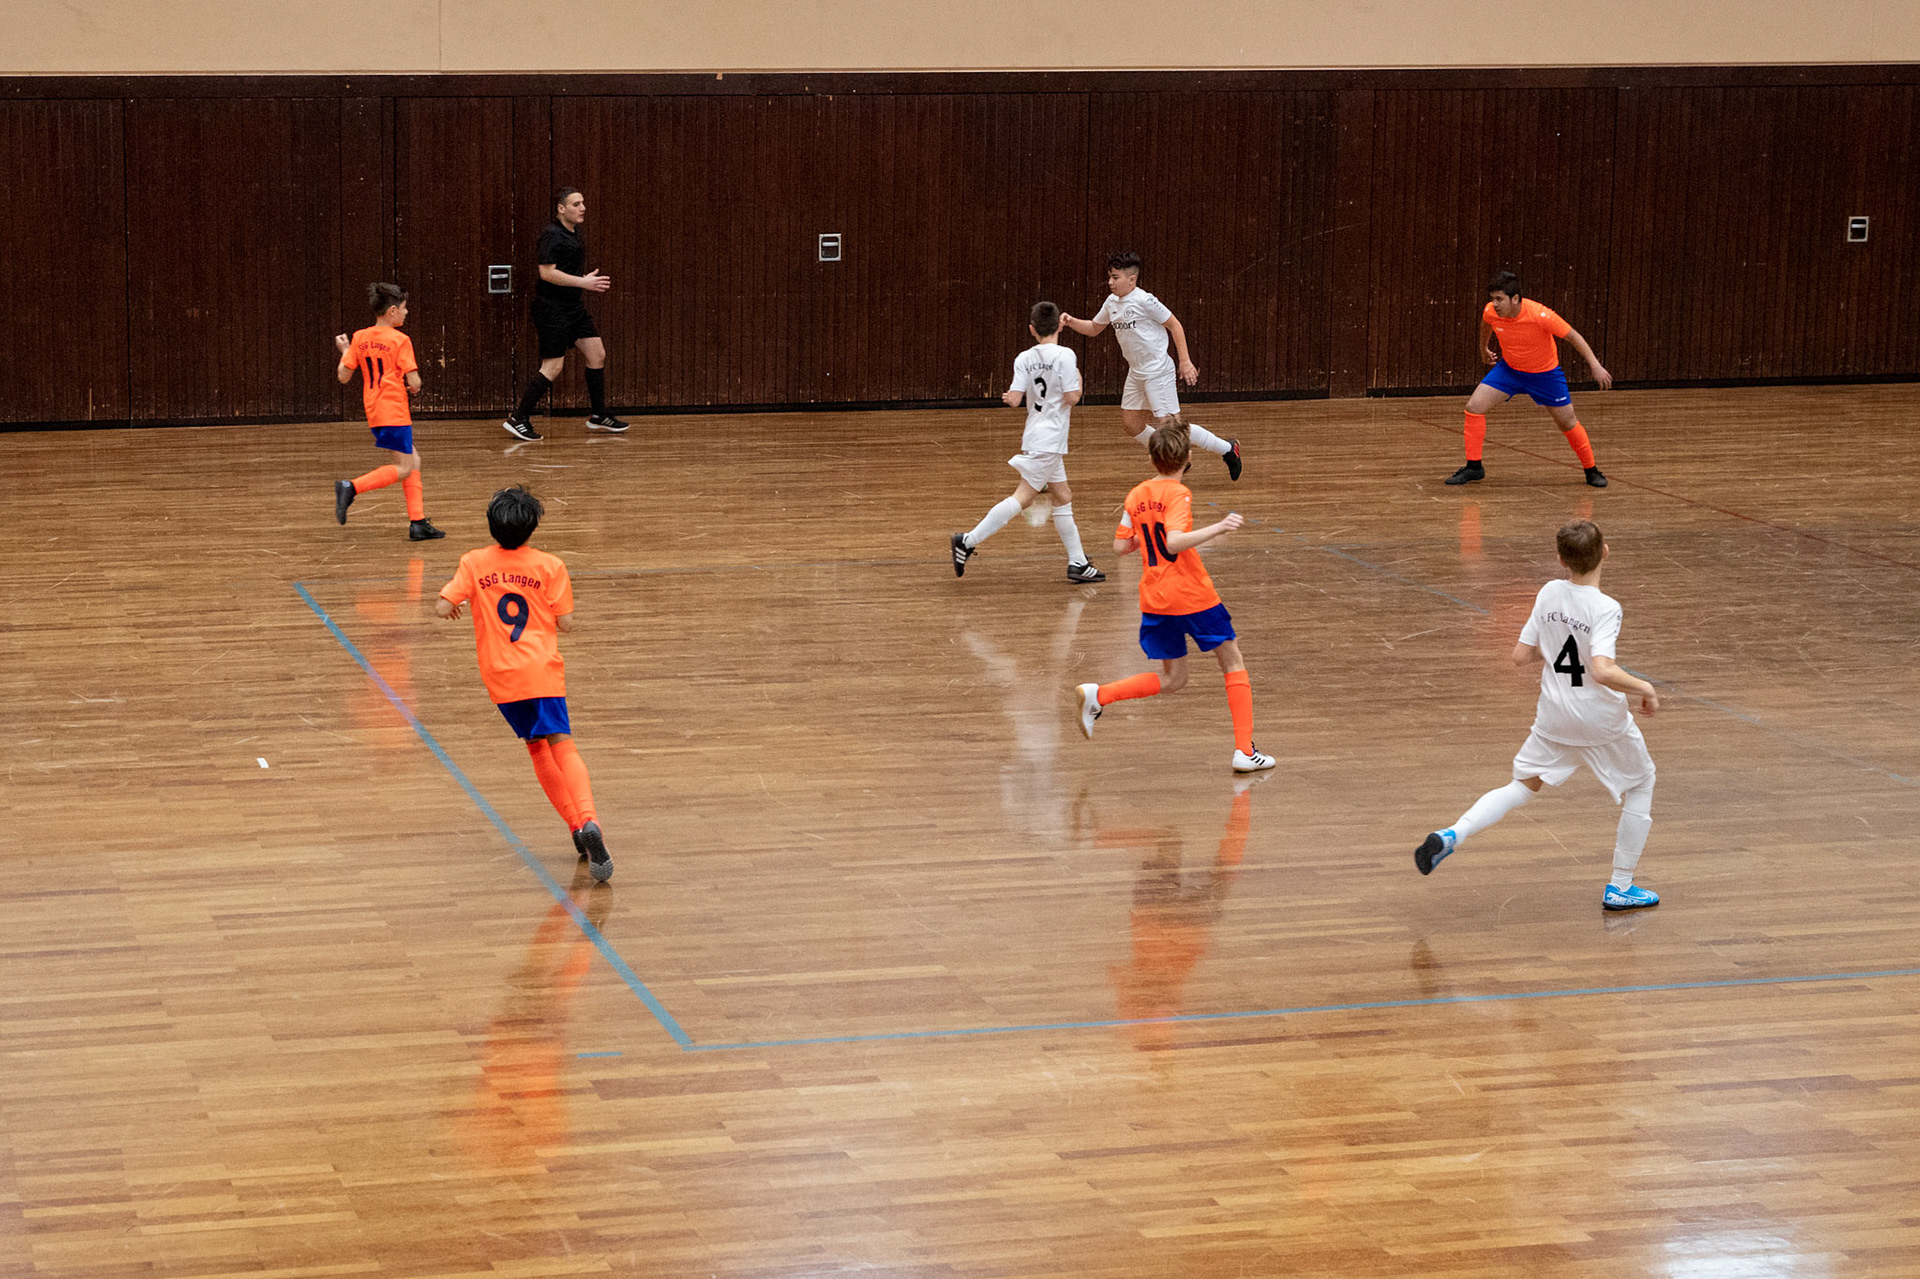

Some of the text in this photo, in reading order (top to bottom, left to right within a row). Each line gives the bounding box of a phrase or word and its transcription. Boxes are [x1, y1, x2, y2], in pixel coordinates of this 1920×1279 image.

[365, 356, 385, 390] 11
[1034, 376, 1047, 412] 3
[1141, 521, 1178, 567] 10
[478, 572, 541, 590] SSG Langen
[497, 592, 529, 643] 9
[1547, 611, 1558, 623] FC
[1553, 634, 1585, 687] 4
